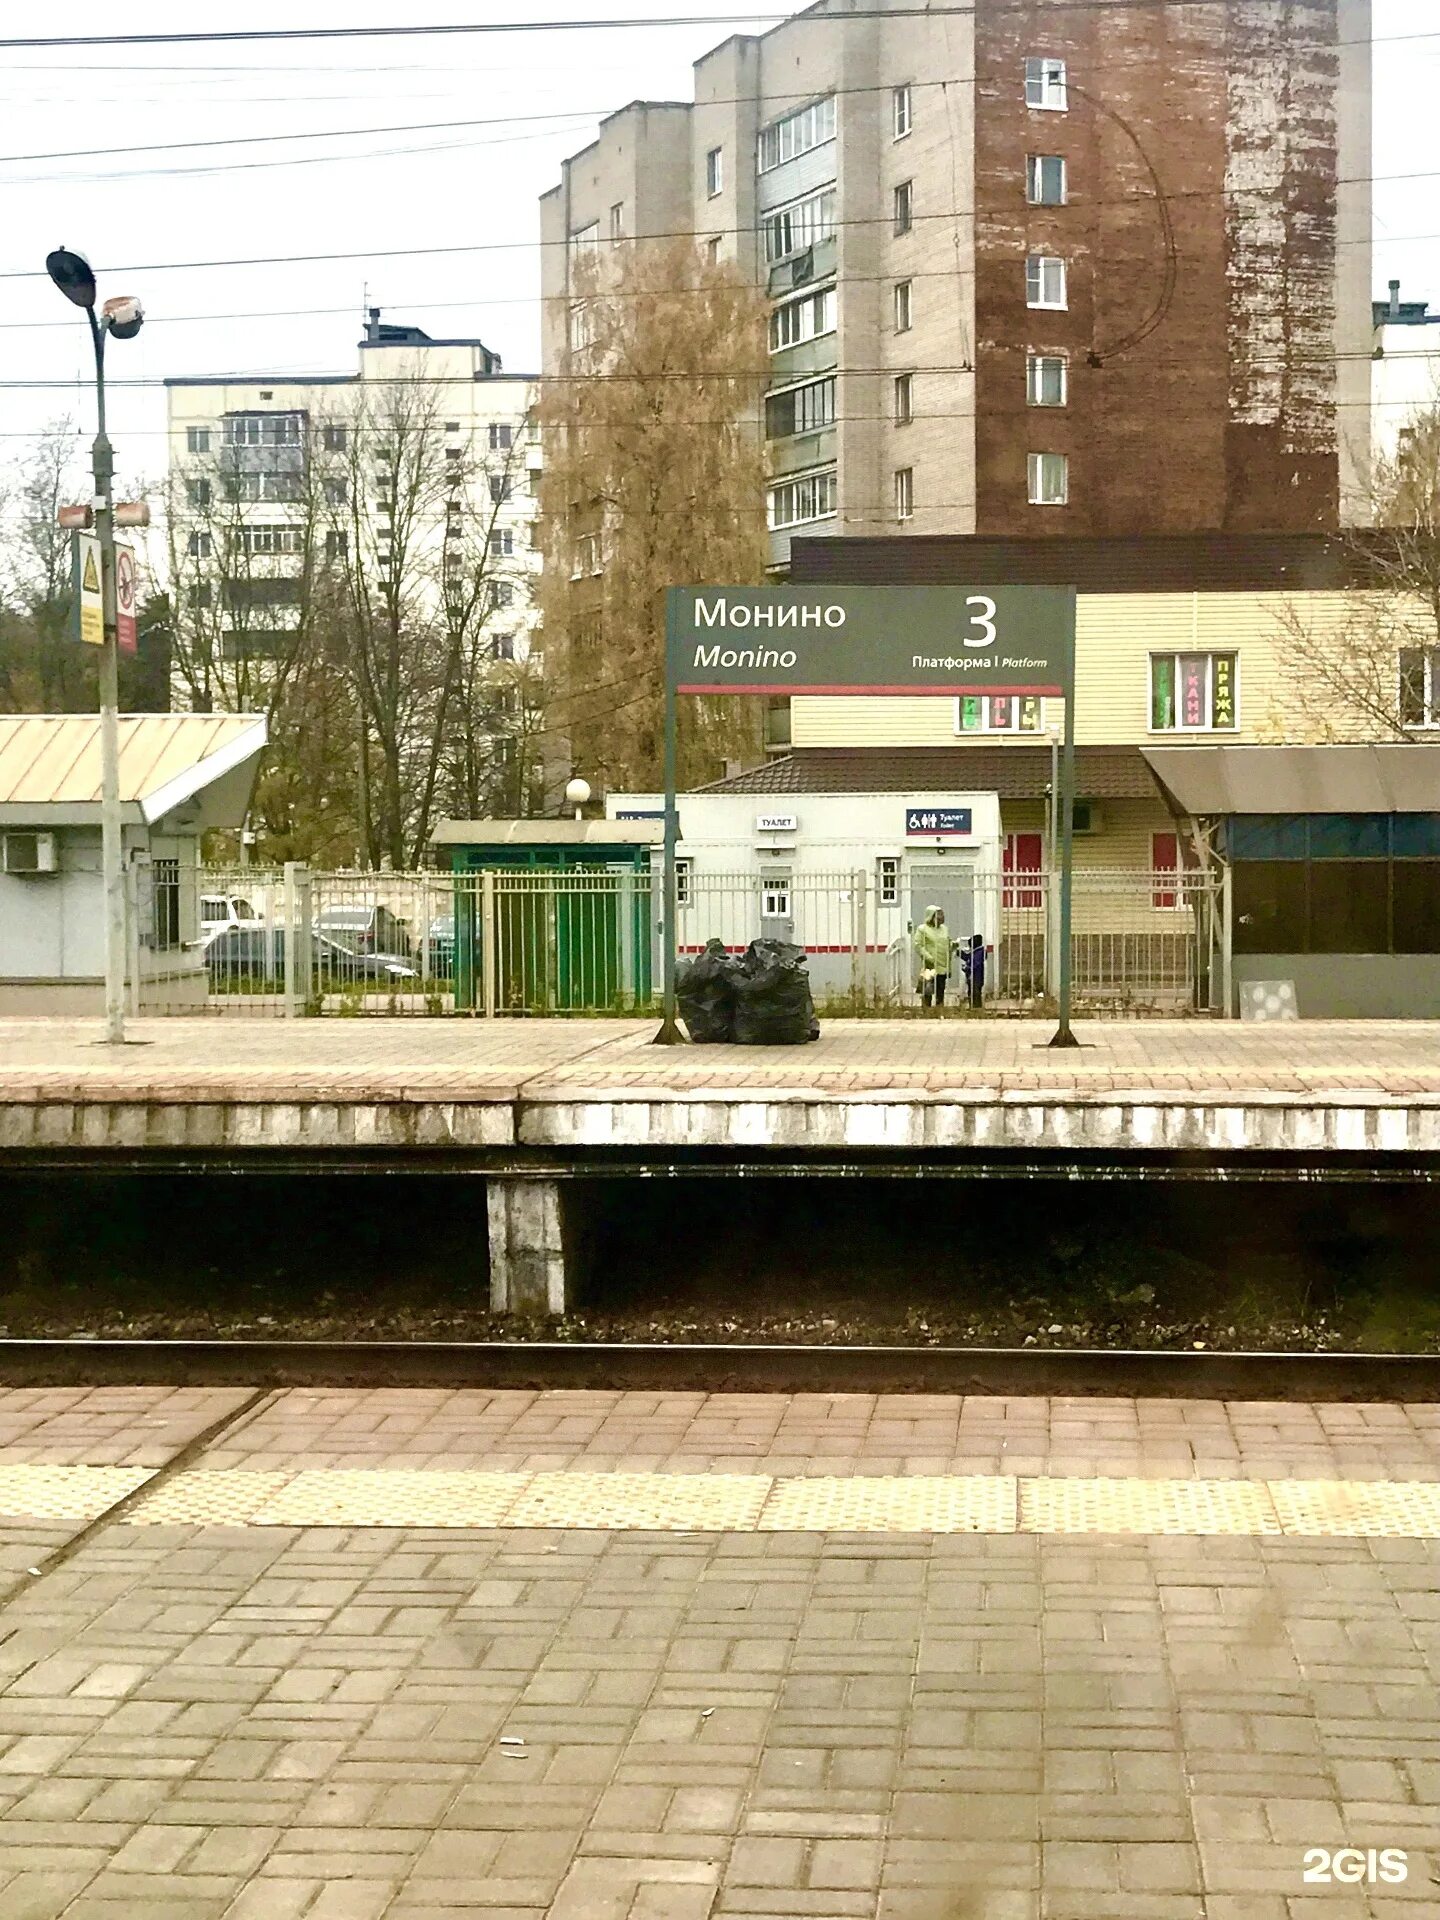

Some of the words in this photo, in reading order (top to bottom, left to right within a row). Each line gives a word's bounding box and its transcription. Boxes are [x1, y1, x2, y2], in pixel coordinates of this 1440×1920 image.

[693, 597, 847, 628] Монино
[962, 595, 997, 648] 3
[693, 644, 798, 669] Monino
[912, 655, 992, 671] Платформа
[1001, 657, 1048, 669] Platform
[1215, 660, 1232, 723] ПРЯЖА
[761, 818, 792, 827] ТУАЛЕТ
